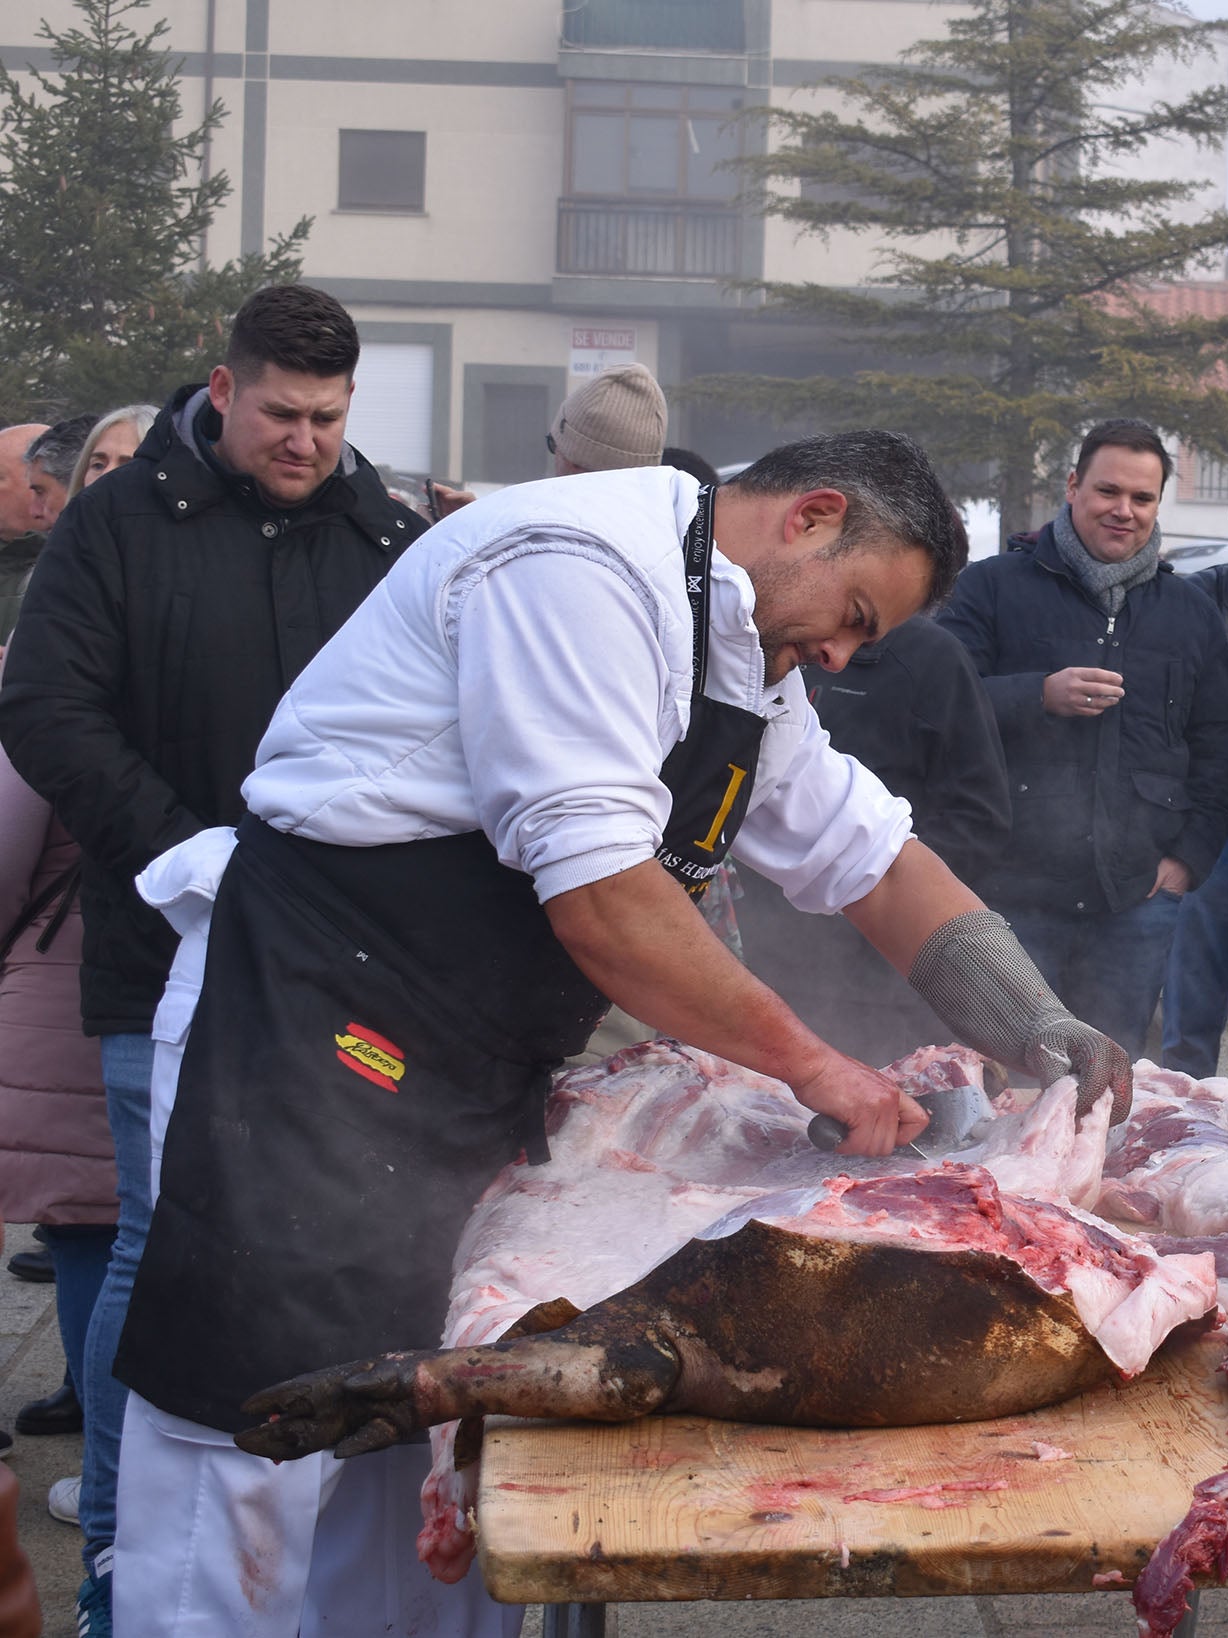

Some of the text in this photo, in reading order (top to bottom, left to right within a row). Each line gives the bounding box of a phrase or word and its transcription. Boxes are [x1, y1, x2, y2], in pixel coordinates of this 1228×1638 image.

[575, 330, 633, 348] SE VENDE
[693, 537, 706, 563] enjoy
